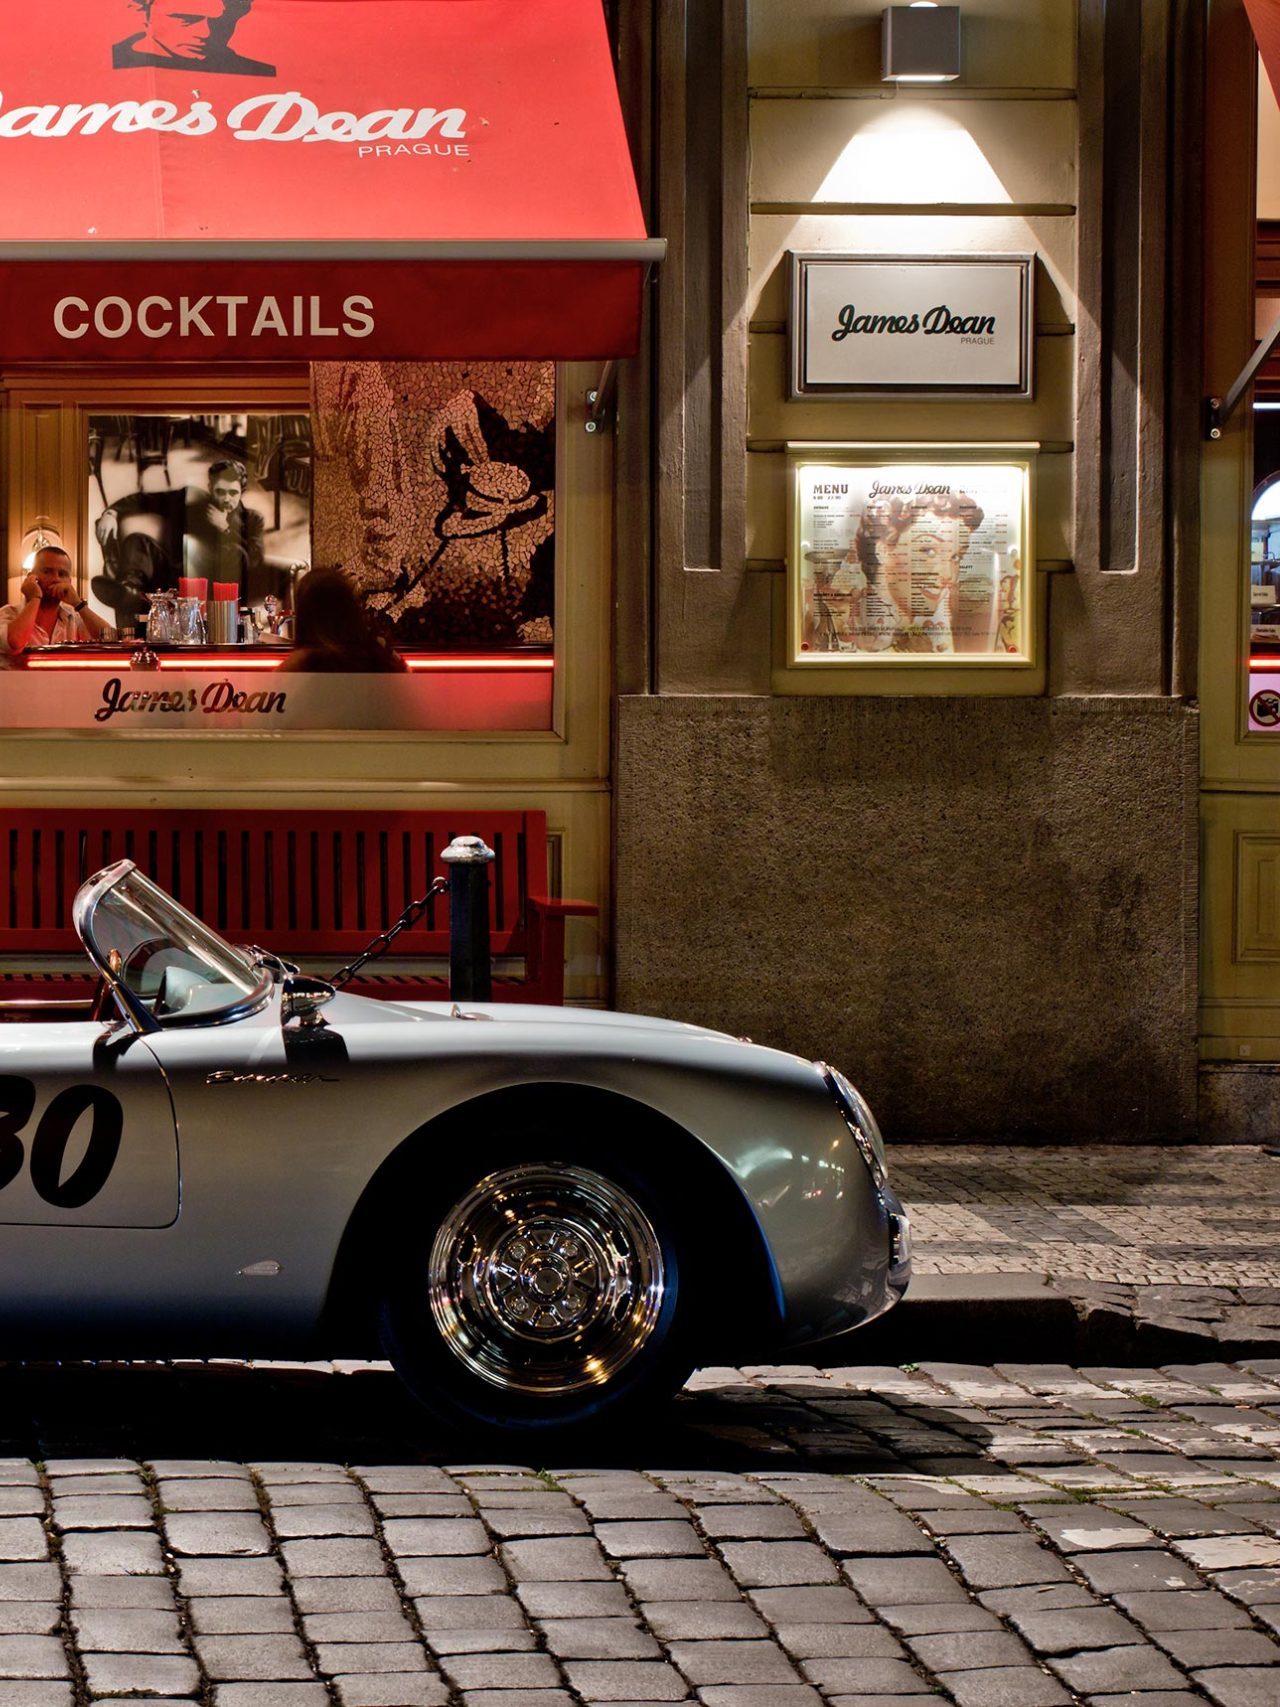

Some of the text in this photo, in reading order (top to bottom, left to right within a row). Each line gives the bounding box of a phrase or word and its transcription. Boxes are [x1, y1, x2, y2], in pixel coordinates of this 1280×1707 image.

[226, 91, 467, 143] Dean
[358, 143, 471, 158] PRAGUE
[53, 294, 376, 339] COCKTAILS
[831, 304, 996, 342] James Dean
[960, 337, 996, 345] PRAGUE
[813, 484, 849, 494] MENU
[868, 480, 912, 498] James
[914, 482, 951, 495] Dean
[94, 678, 287, 722] James Dean
